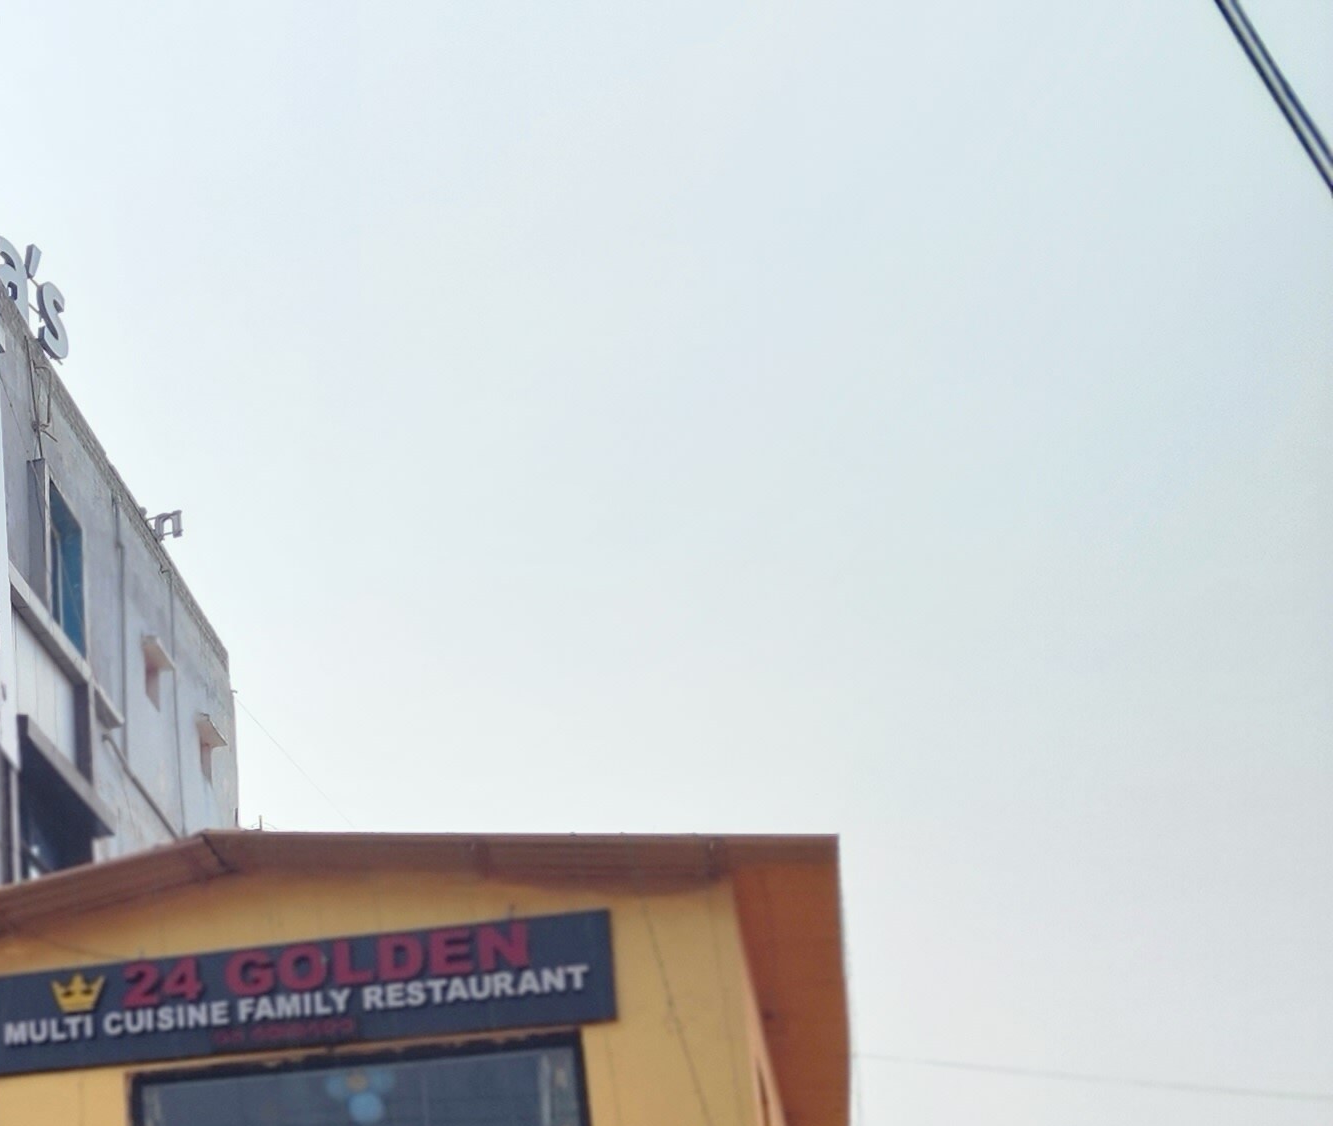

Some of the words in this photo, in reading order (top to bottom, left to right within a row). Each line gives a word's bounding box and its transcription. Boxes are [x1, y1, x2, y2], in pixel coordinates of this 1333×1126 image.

[4, 1015, 93, 1045] MULTI
[103, 1001, 228, 1036] CUISINE
[238, 989, 351, 1022] FAMILY
[363, 964, 589, 1011] RESTAURANT
[122, 955, 202, 1007] 24
[225, 921, 528, 996] GOLDEN
